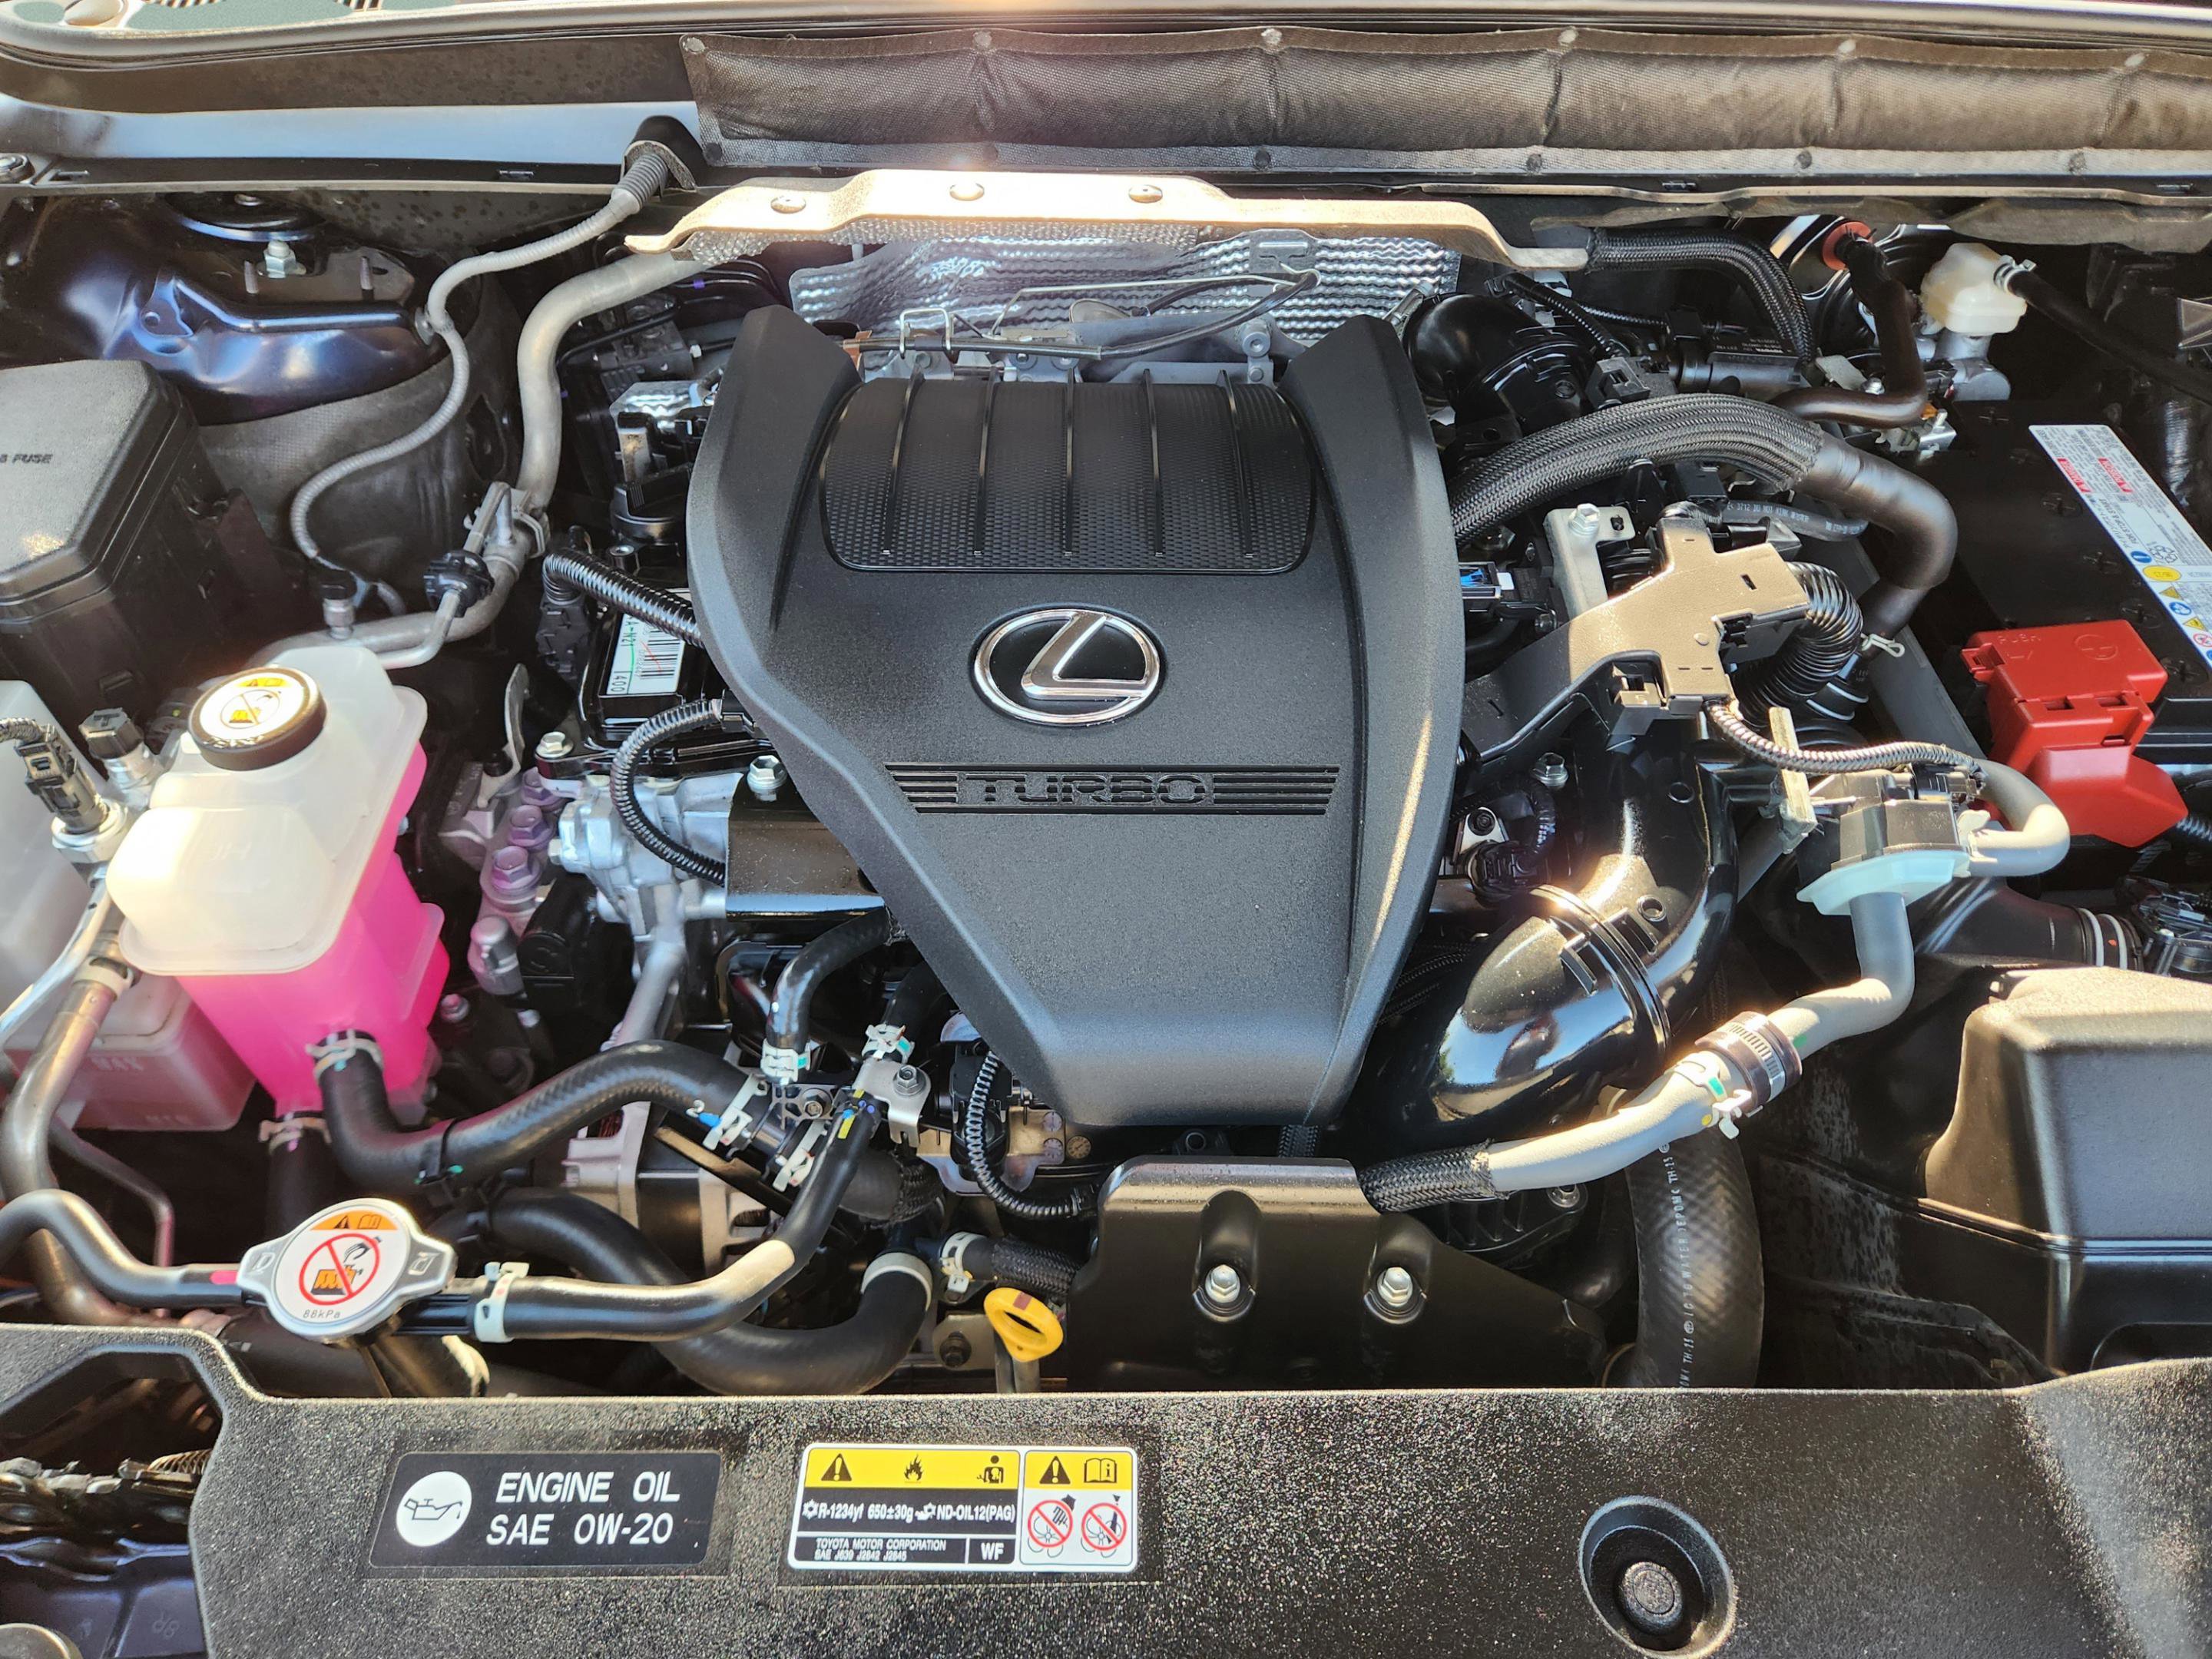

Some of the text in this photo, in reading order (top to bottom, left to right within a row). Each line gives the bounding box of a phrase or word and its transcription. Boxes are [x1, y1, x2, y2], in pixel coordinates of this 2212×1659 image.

[12, 453, 53, 464] FUSE
[965, 773, 1206, 805] TURBO
[303, 1309, 341, 1319] 88kPa
[495, 1471, 680, 1503] ENGINE OIL
[818, 1502, 1016, 1523] R-1234yf 650±30g ND-OIL12(PAG)
[486, 1512, 674, 1545] SAE 0W-20
[816, 1538, 946, 1551] TOYOTA MOTOR CORPORATION
[981, 1542, 1005, 1561] WF
